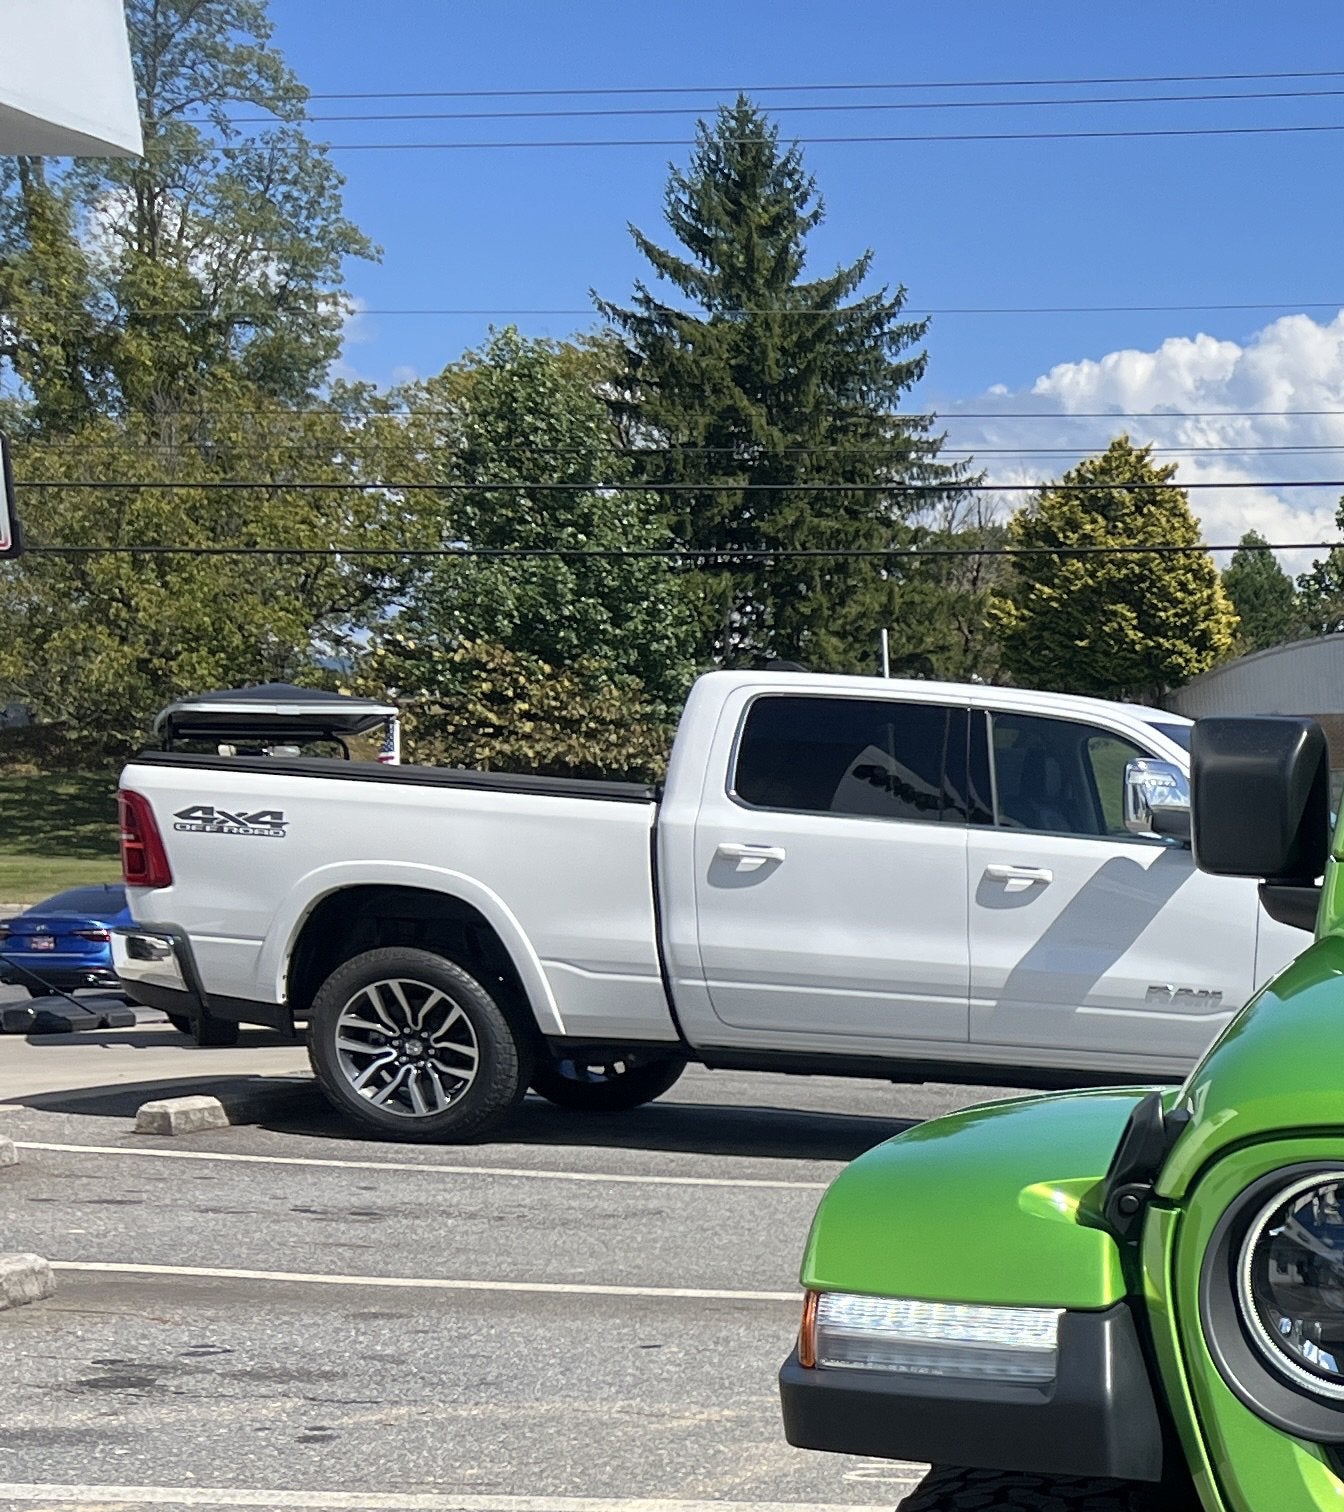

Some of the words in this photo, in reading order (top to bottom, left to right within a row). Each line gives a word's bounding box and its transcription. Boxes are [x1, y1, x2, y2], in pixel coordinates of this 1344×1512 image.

[175, 823, 218, 832] OFF
[223, 826, 283, 836] ROAD
[1145, 985, 1223, 1008] RAM
